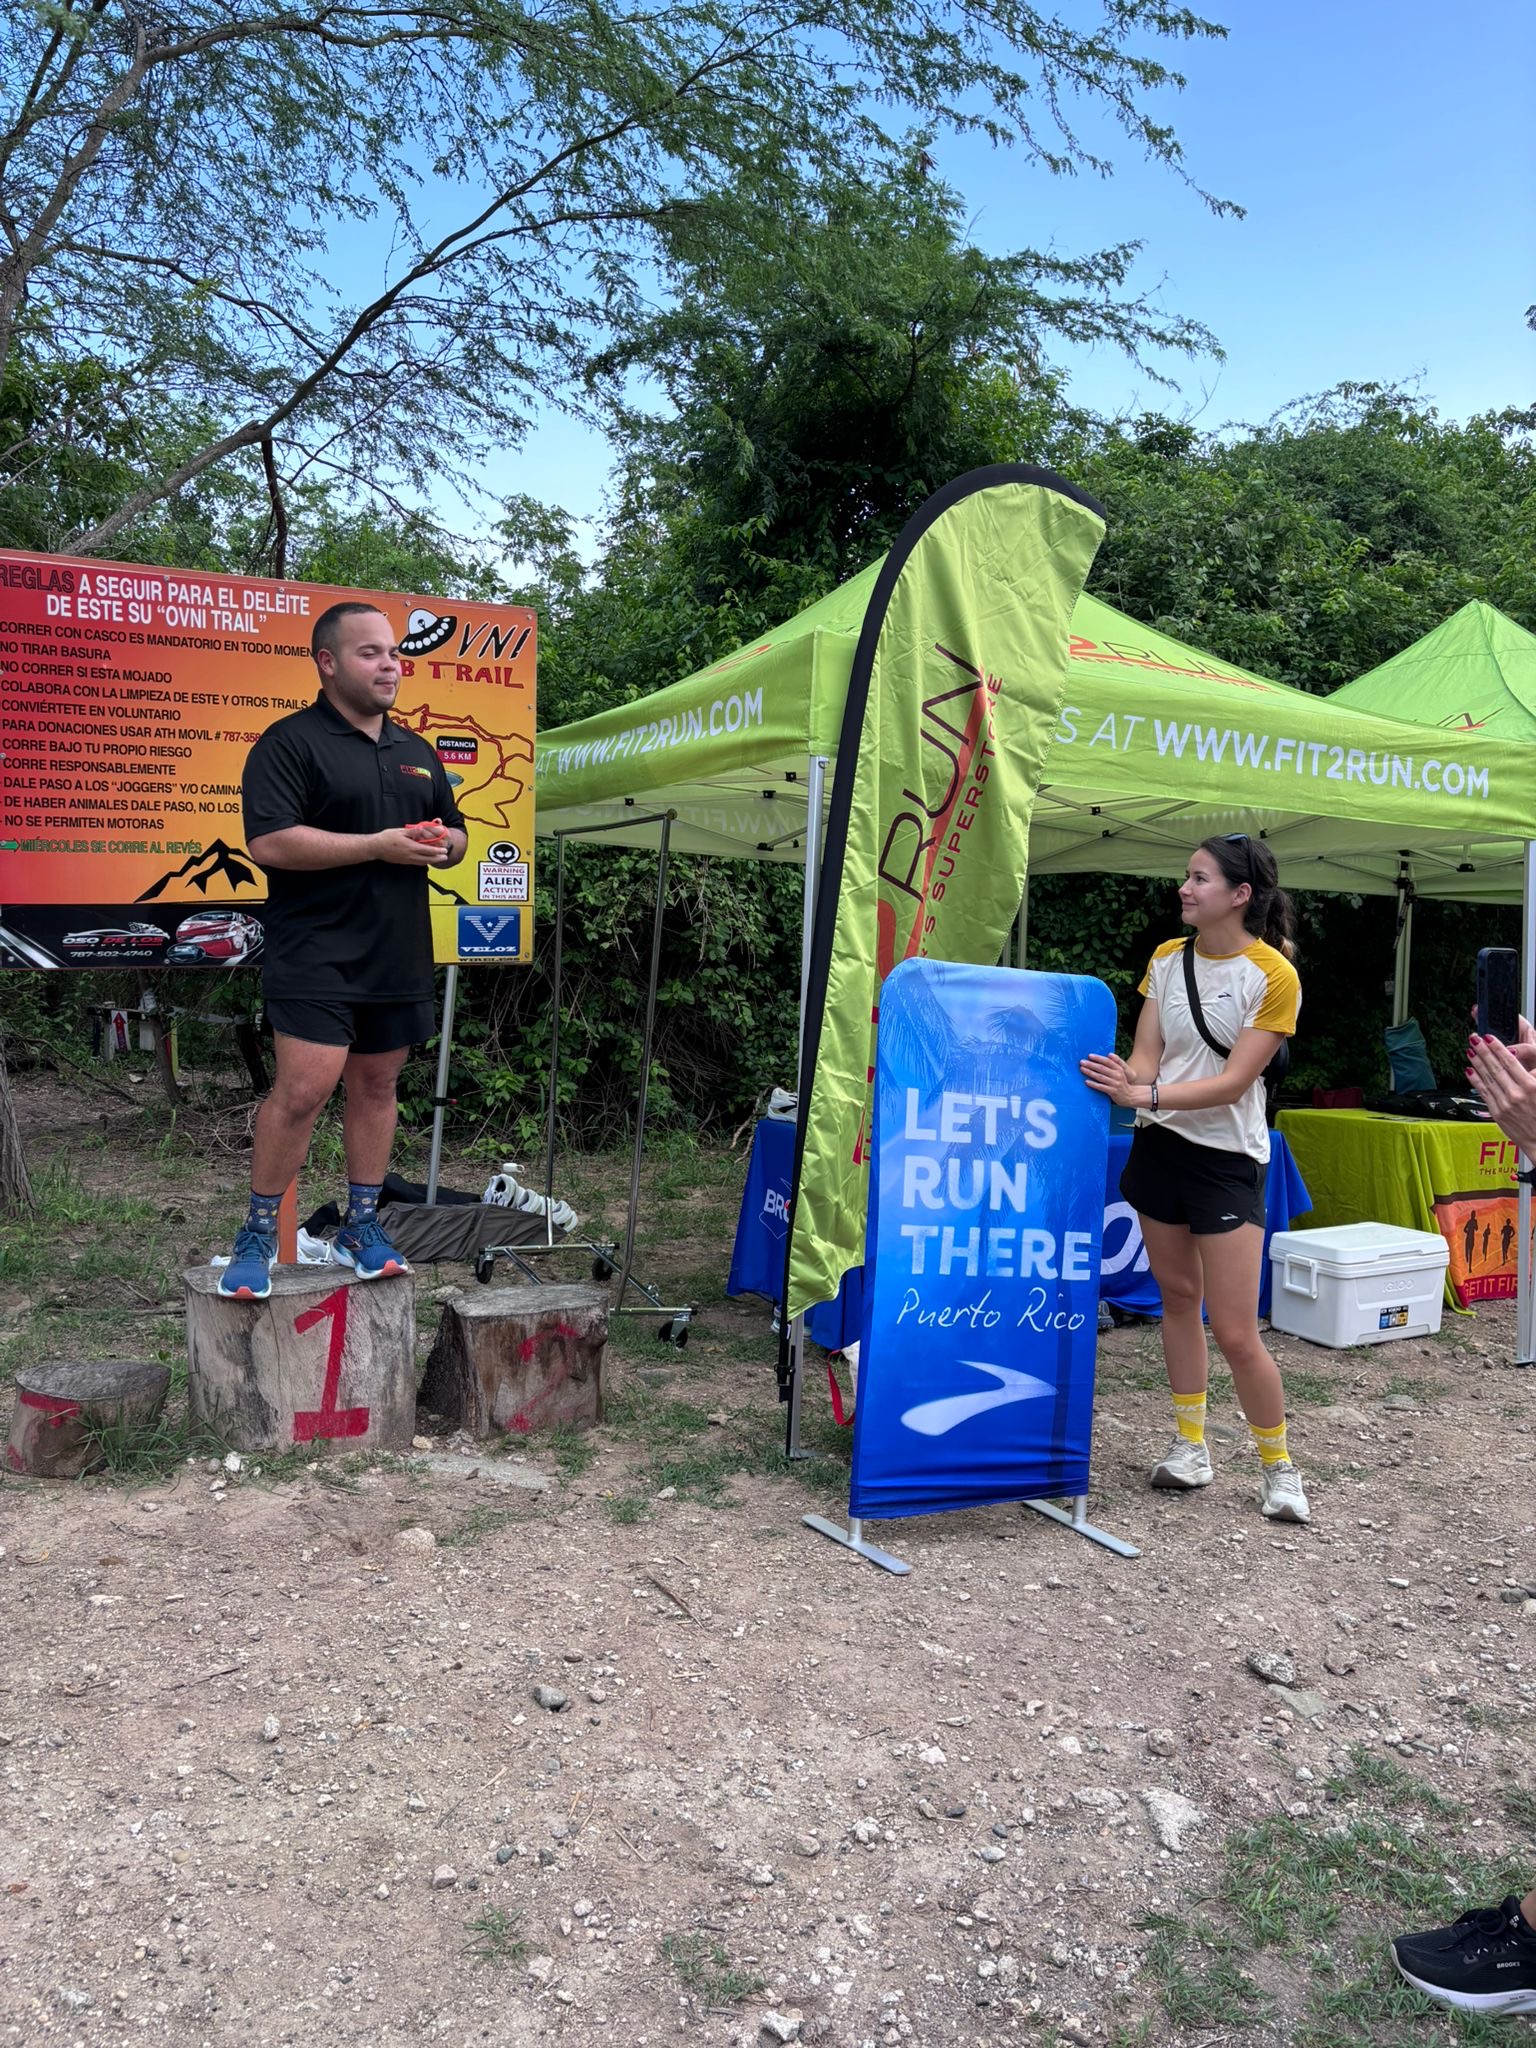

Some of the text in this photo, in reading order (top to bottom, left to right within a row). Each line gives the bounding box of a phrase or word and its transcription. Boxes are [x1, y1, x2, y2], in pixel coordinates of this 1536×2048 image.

[0, 564, 310, 616] REGLAS A SEGUIR PARA EL DELEITE
[47, 594, 72, 617] DE
[77, 597, 124, 622] ESTE
[128, 602, 152, 624] SU
[0, 621, 312, 658] CORRER CON CASCO ES MANDATORIO EN TODO MOMEN
[0, 641, 111, 660] NO TIRAR BASURA
[1, 661, 172, 684] NO CORRER SI ESTA MOJADO
[428, 661, 524, 689] TRAIL
[1, 680, 308, 710] COLABORA CON LA LIMPIEZA DE ESTE Y OTROS TRAILS
[2, 699, 181, 721] CONVIÉRTETE EN VOLUNTARIO
[2, 719, 261, 743] PARA DONACIONES USAR ATH MOVIL # 787-358
[557, 687, 764, 775] WWW.FIT2RUN.COM
[2, 738, 192, 758] CORRE BAJO TU PROPIO RIESGO
[439, 740, 476, 749] DISTANCIA
[444, 752, 456, 760] 5.6
[1088, 712, 1146, 751] AT
[1154, 719, 1490, 799] WWW.FIT2RUN.COM
[3, 758, 176, 775] CORRE RESPONSABLEMENTE
[4, 776, 37, 789] DALE
[39, 778, 72, 790] PASO
[74, 780, 83, 791] A
[85, 780, 109, 792] LOS
[180, 783, 198, 795] Y/O
[200, 784, 242, 796] CAMINA
[4, 795, 240, 814] DE HABER ANIMALES DALE PASO, NO LOS
[4, 815, 164, 830] NO SE PERMITEN MOTORAS
[20, 836, 202, 854] MIÉRCOLES SE CORRE AL REVÉS
[485, 877, 522, 885] ALIEN
[904, 1087, 1058, 1149] LET'S
[902, 1155, 1027, 1213] RUN
[900, 1223, 1092, 1281] THERE
[1464, 1279, 1482, 1298] GET
[1484, 1278, 1495, 1294] IT
[896, 1286, 1086, 1332] Puerto Rico
[293, 1286, 369, 1442] 1
